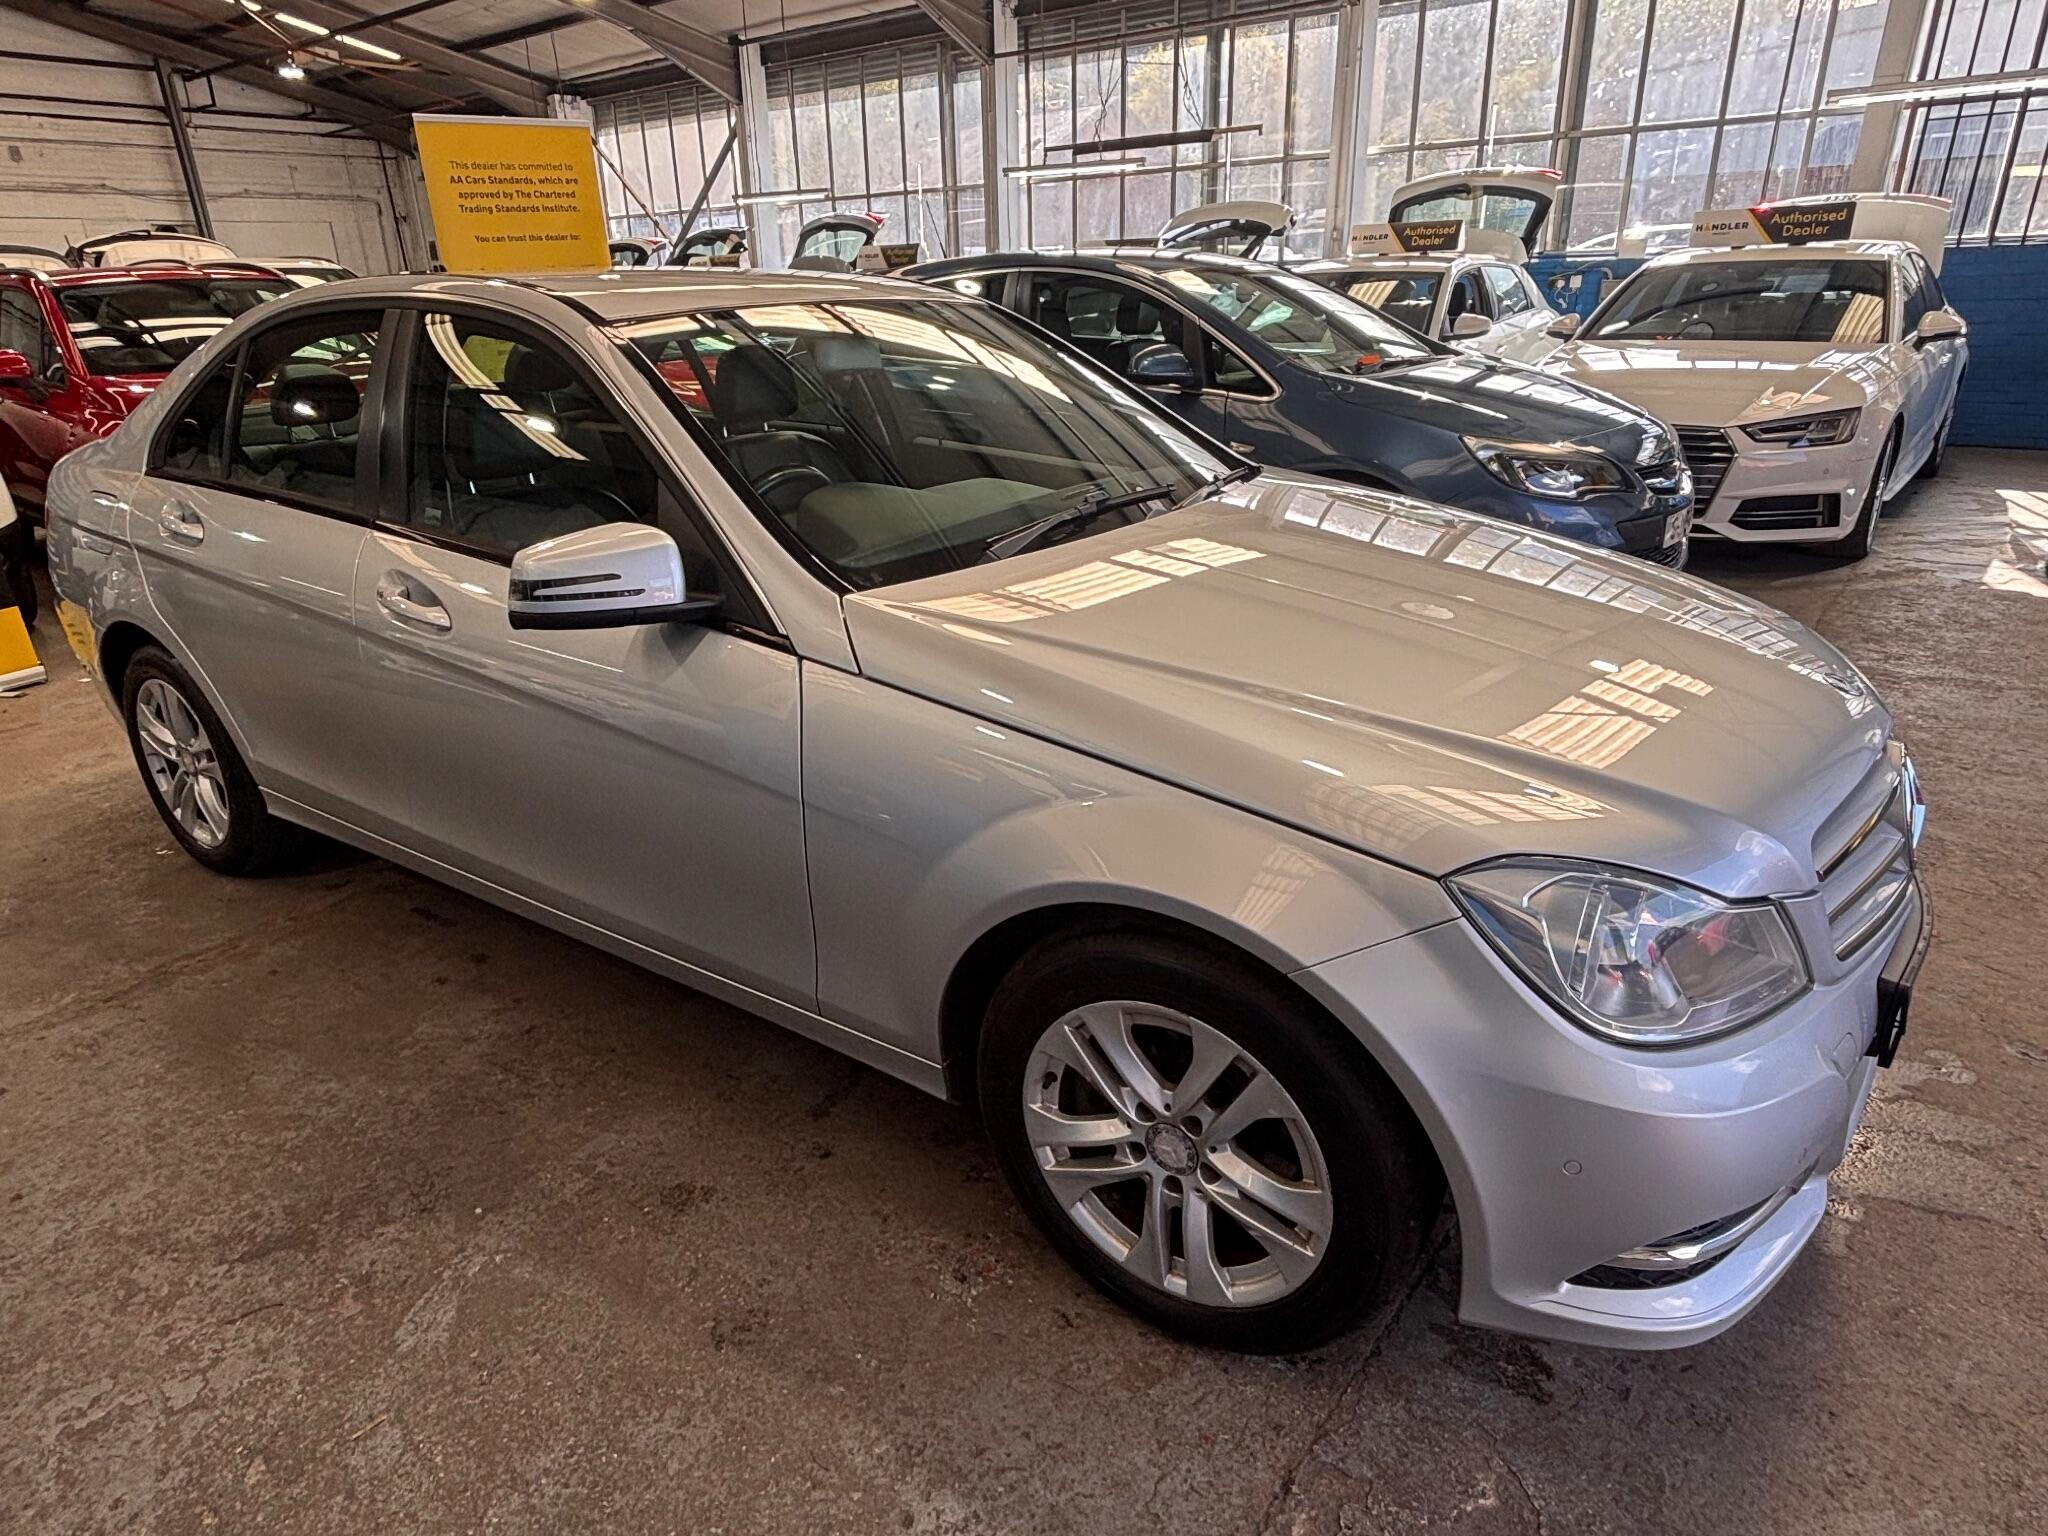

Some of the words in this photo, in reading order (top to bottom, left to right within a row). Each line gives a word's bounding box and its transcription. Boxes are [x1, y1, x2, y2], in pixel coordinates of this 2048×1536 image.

[449, 161, 469, 170] This
[471, 161, 498, 170] dealer
[500, 162, 516, 171] has
[518, 162, 561, 171] committed
[563, 163, 573, 171] to
[450, 176, 464, 184] AA
[466, 176, 486, 184] Cars
[488, 176, 536, 186] Standards,
[538, 176, 563, 185] which
[458, 190, 501, 200] approved
[503, 190, 513, 200] by
[515, 190, 531, 199] The
[534, 190, 576, 199] Chartered
[458, 205, 493, 214] Trading
[495, 205, 540, 213] Standards
[542, 204, 580, 212] Institute.
[1771, 208, 1847, 224] Authorised
[1404, 225, 1456, 236] Authorised
[1783, 225, 1829, 236] Dealer
[475, 235, 490, 243] You
[507, 234, 527, 242] trust
[529, 233, 543, 241] this
[545, 233, 568, 241] dealer
[570, 233, 581, 241] to:
[1412, 237, 1444, 246] Dealer
